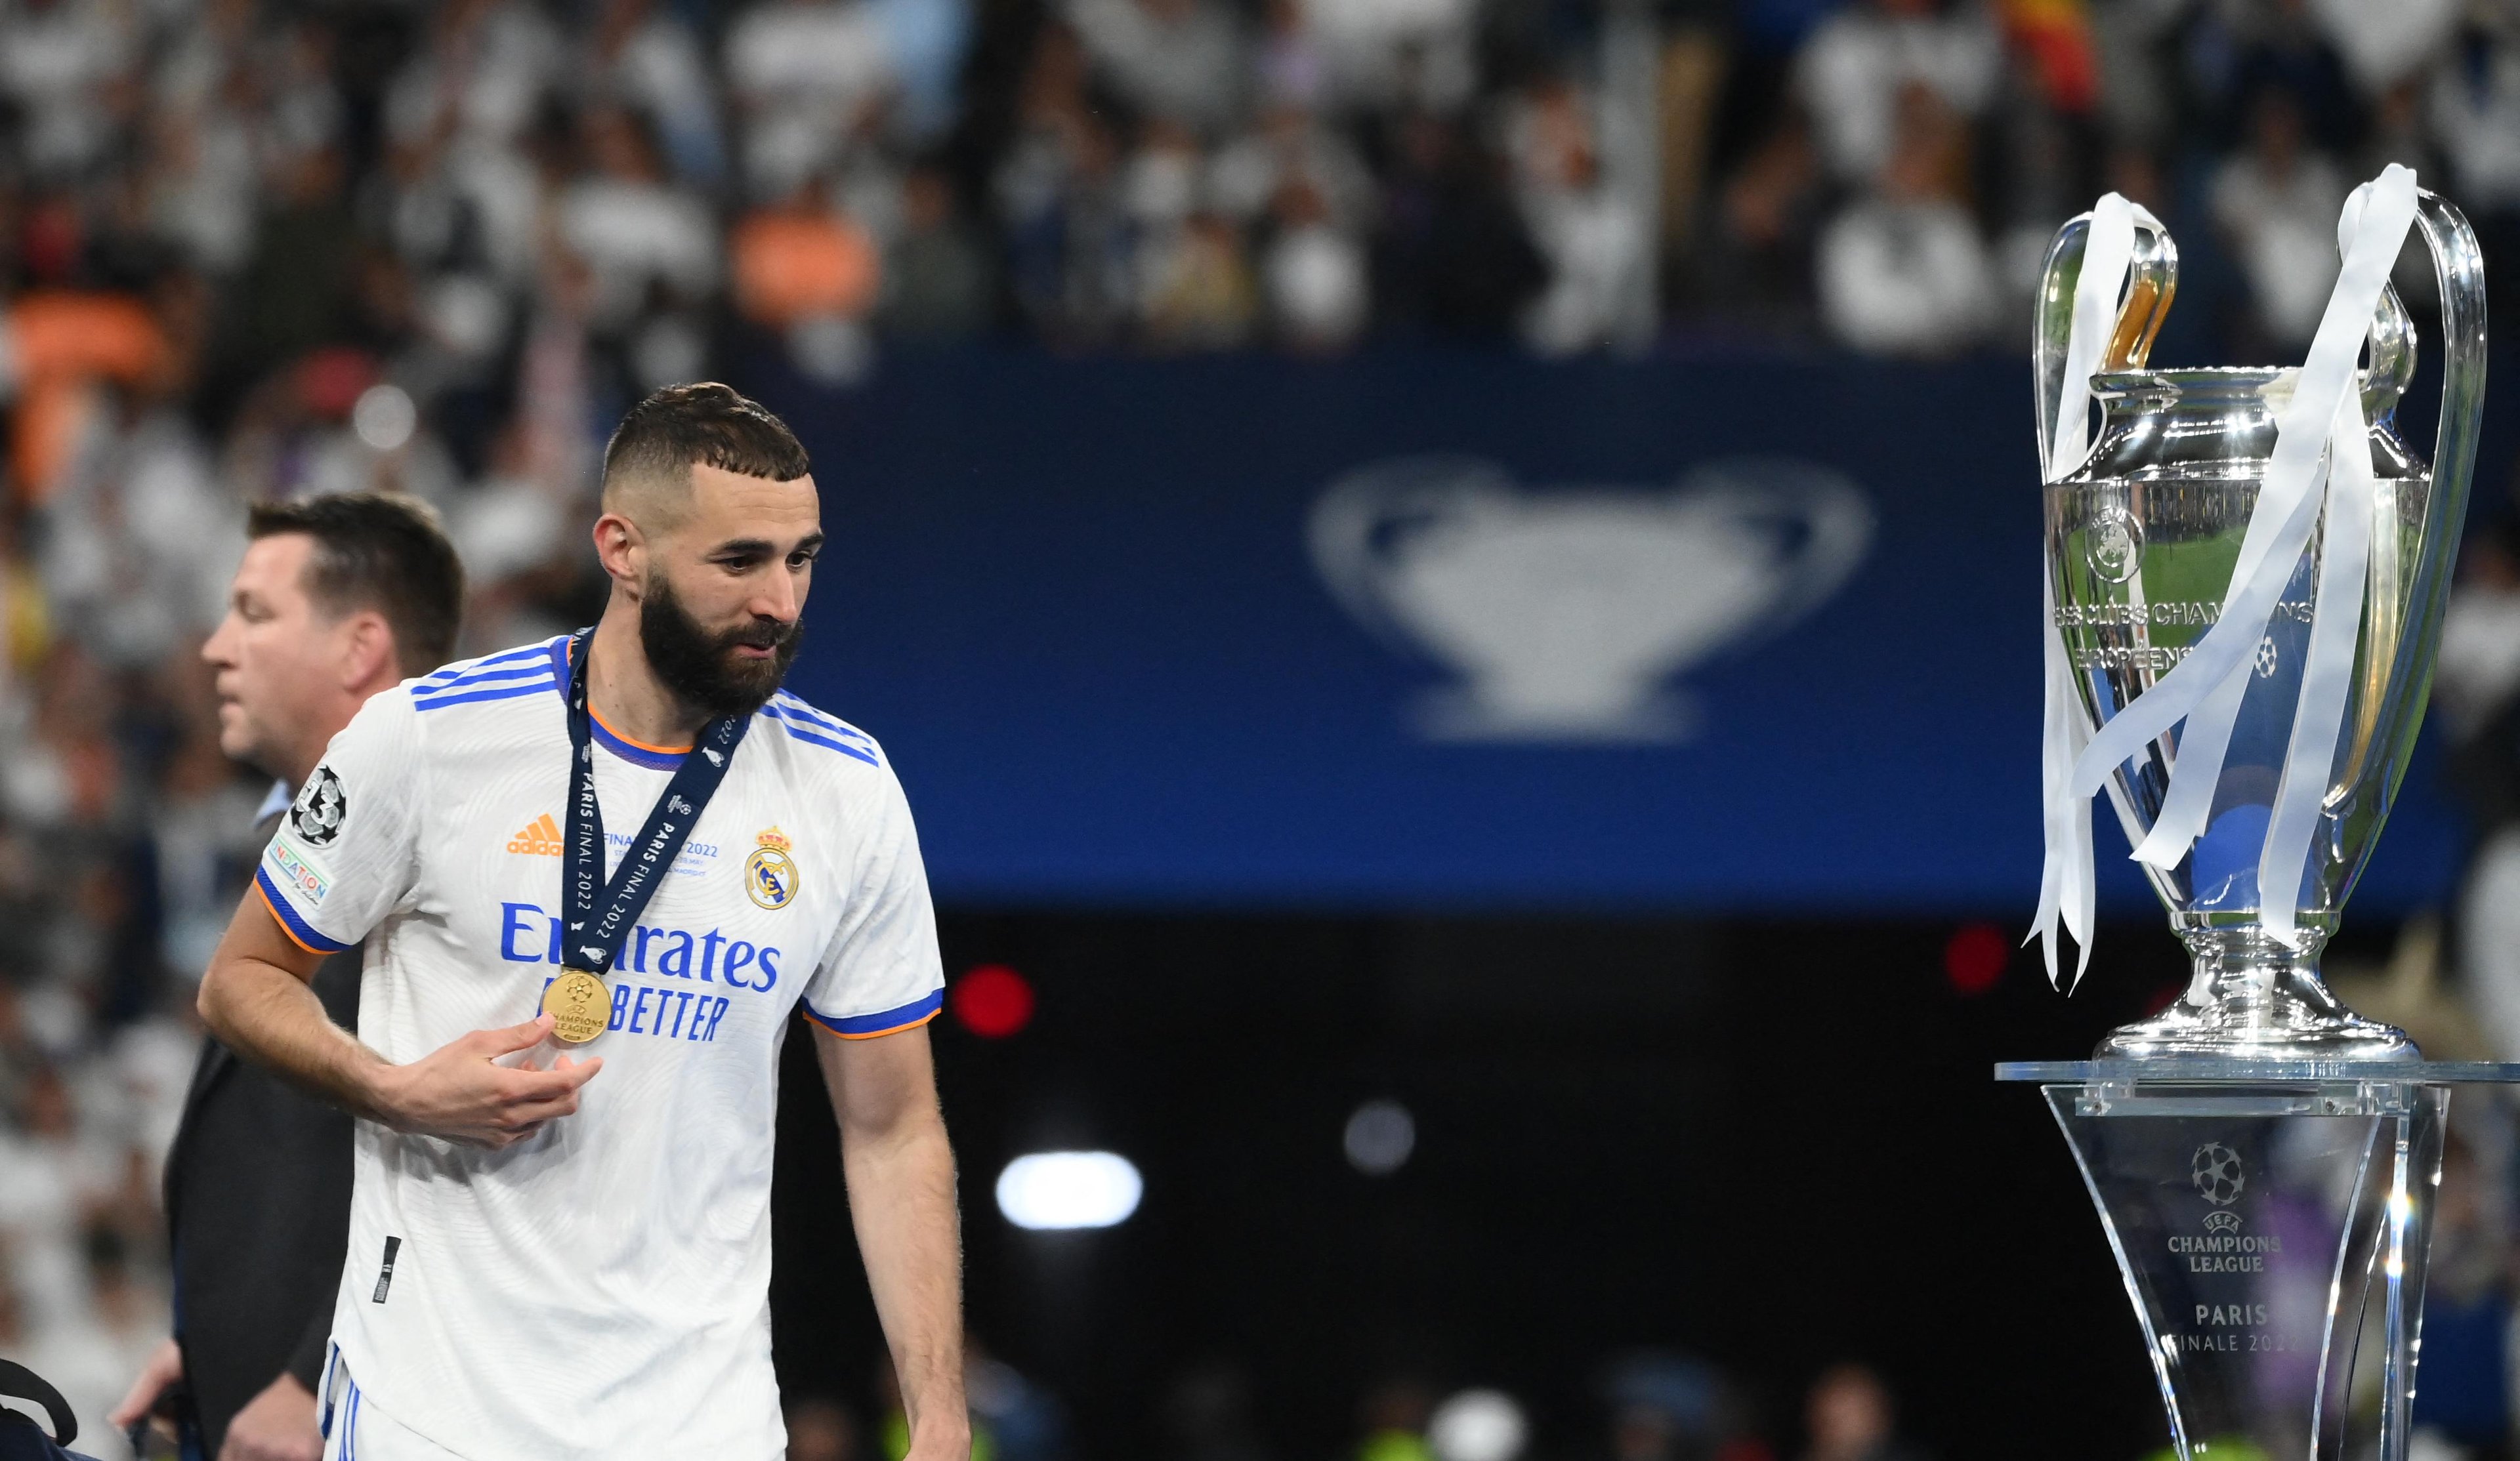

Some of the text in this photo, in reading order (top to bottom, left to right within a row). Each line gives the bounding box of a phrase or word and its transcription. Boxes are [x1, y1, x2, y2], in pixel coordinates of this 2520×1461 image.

[298, 780, 333, 825] 13
[581, 772, 594, 818] PARIS
[507, 838, 564, 857] adida
[579, 823, 593, 865] FINAL
[604, 833, 718, 857] FINA 2022
[643, 822, 675, 863] PARIS
[578, 872, 591, 910] 2022
[619, 864, 650, 900] FINAL
[597, 903, 625, 939] 2022
[552, 1012, 604, 1027] HAMPIONS
[555, 1022, 592, 1034] LEAGUE
[608, 985, 729, 1042] BETTER
[2204, 1214, 2240, 1232] UEFA
[2168, 1236, 2282, 1253] CHAMPIONS
[2189, 1256, 2264, 1273] LEAGUE
[2196, 1304, 2268, 1326] PARIS
